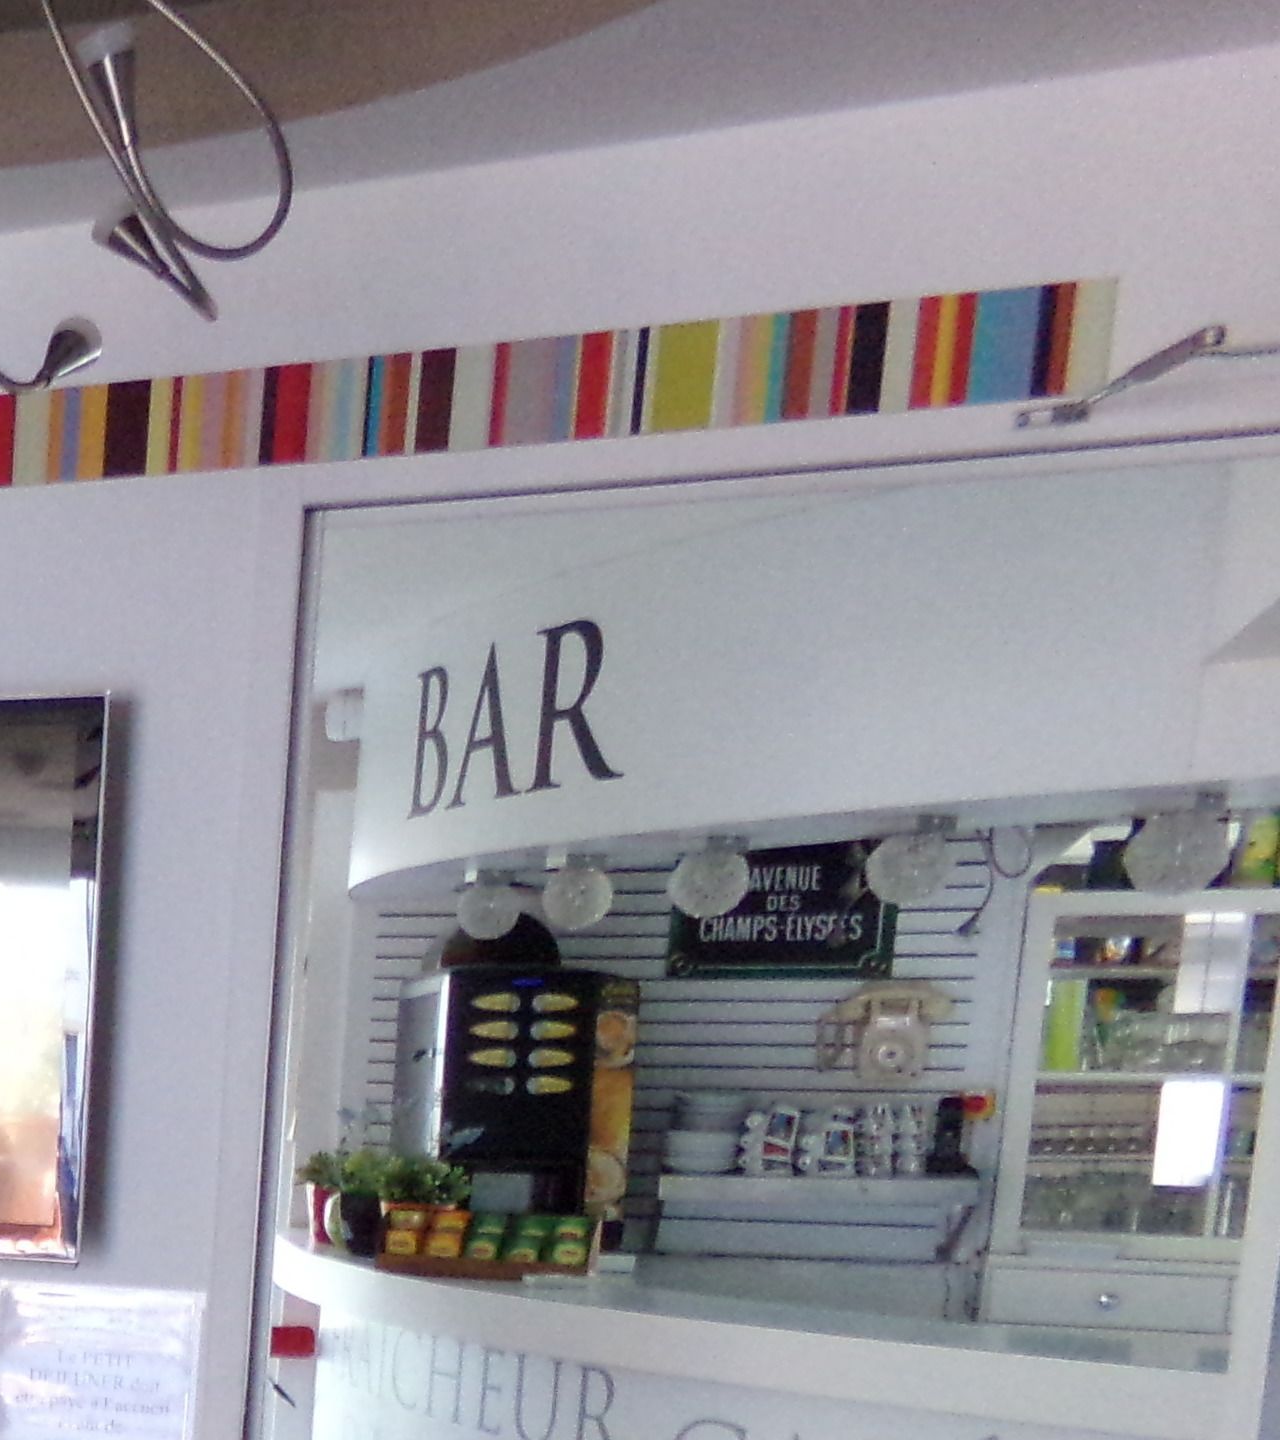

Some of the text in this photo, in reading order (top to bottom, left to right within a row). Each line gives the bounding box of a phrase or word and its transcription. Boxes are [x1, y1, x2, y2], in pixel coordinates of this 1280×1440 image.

[407, 618, 624, 820] BAR
[748, 865, 821, 892] AVENUE
[766, 895, 801, 912] DES
